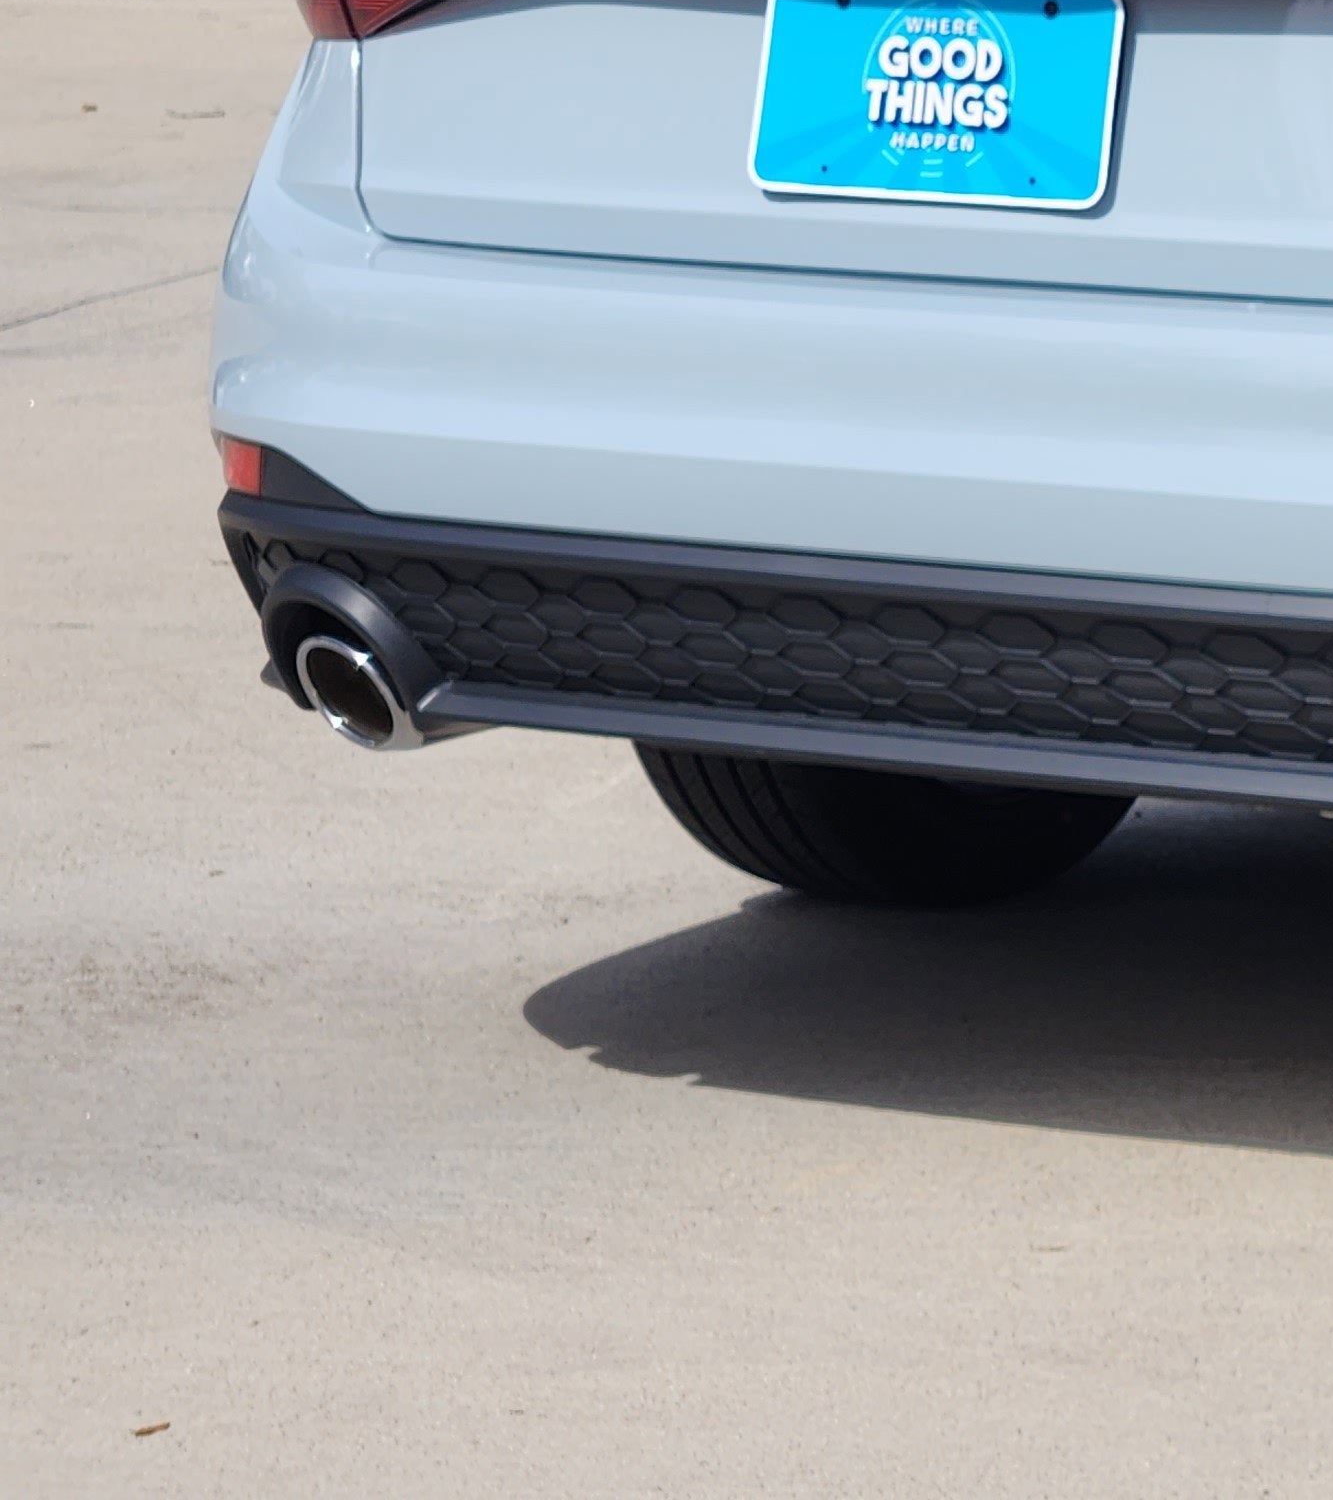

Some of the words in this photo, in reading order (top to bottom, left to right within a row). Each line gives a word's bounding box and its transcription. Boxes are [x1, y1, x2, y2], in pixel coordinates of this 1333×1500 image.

[904, 15, 980, 37] WHERE
[878, 34, 1003, 82] GOOD
[865, 78, 1009, 129] THINGS
[888, 131, 976, 153] HAPPEN
